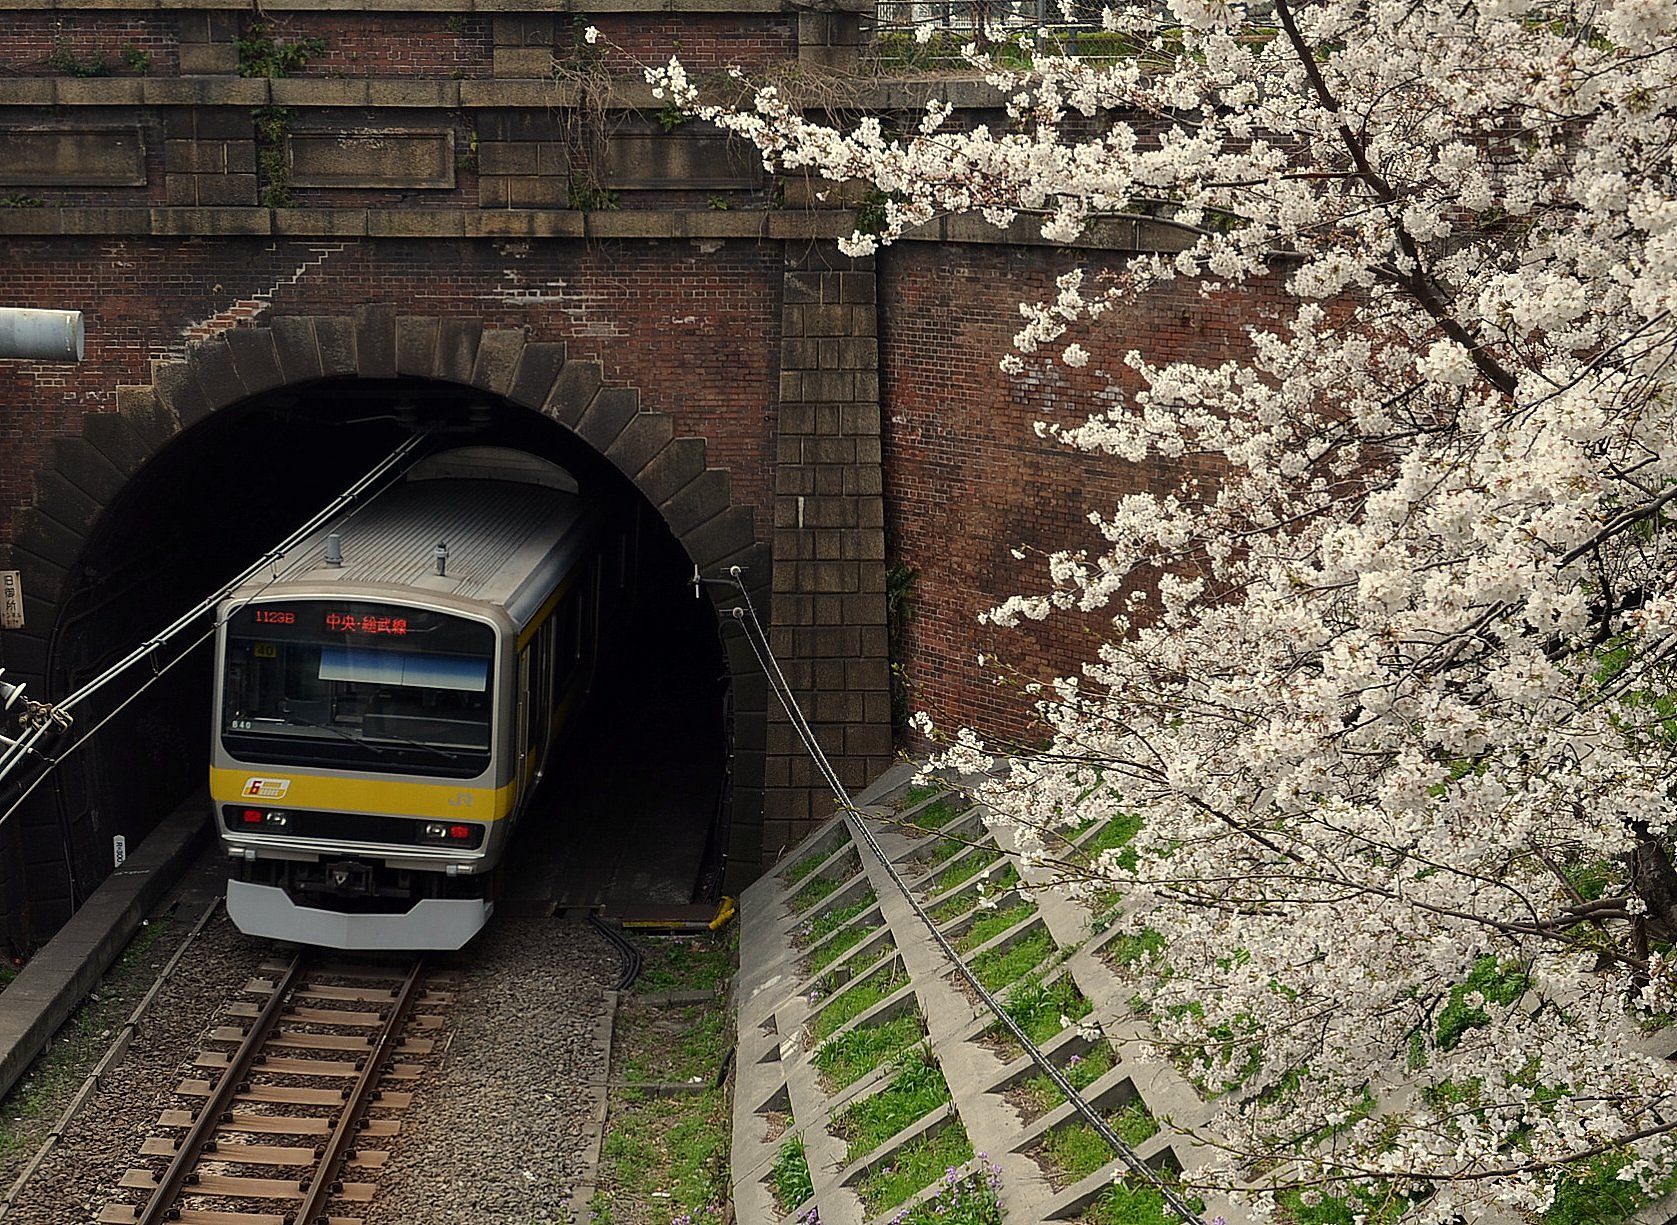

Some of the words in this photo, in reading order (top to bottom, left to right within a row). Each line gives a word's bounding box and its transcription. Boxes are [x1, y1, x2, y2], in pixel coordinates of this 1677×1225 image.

[255, 610, 296, 625] 1123B
[257, 644, 274, 657] 40
[448, 792, 474, 807] JR
